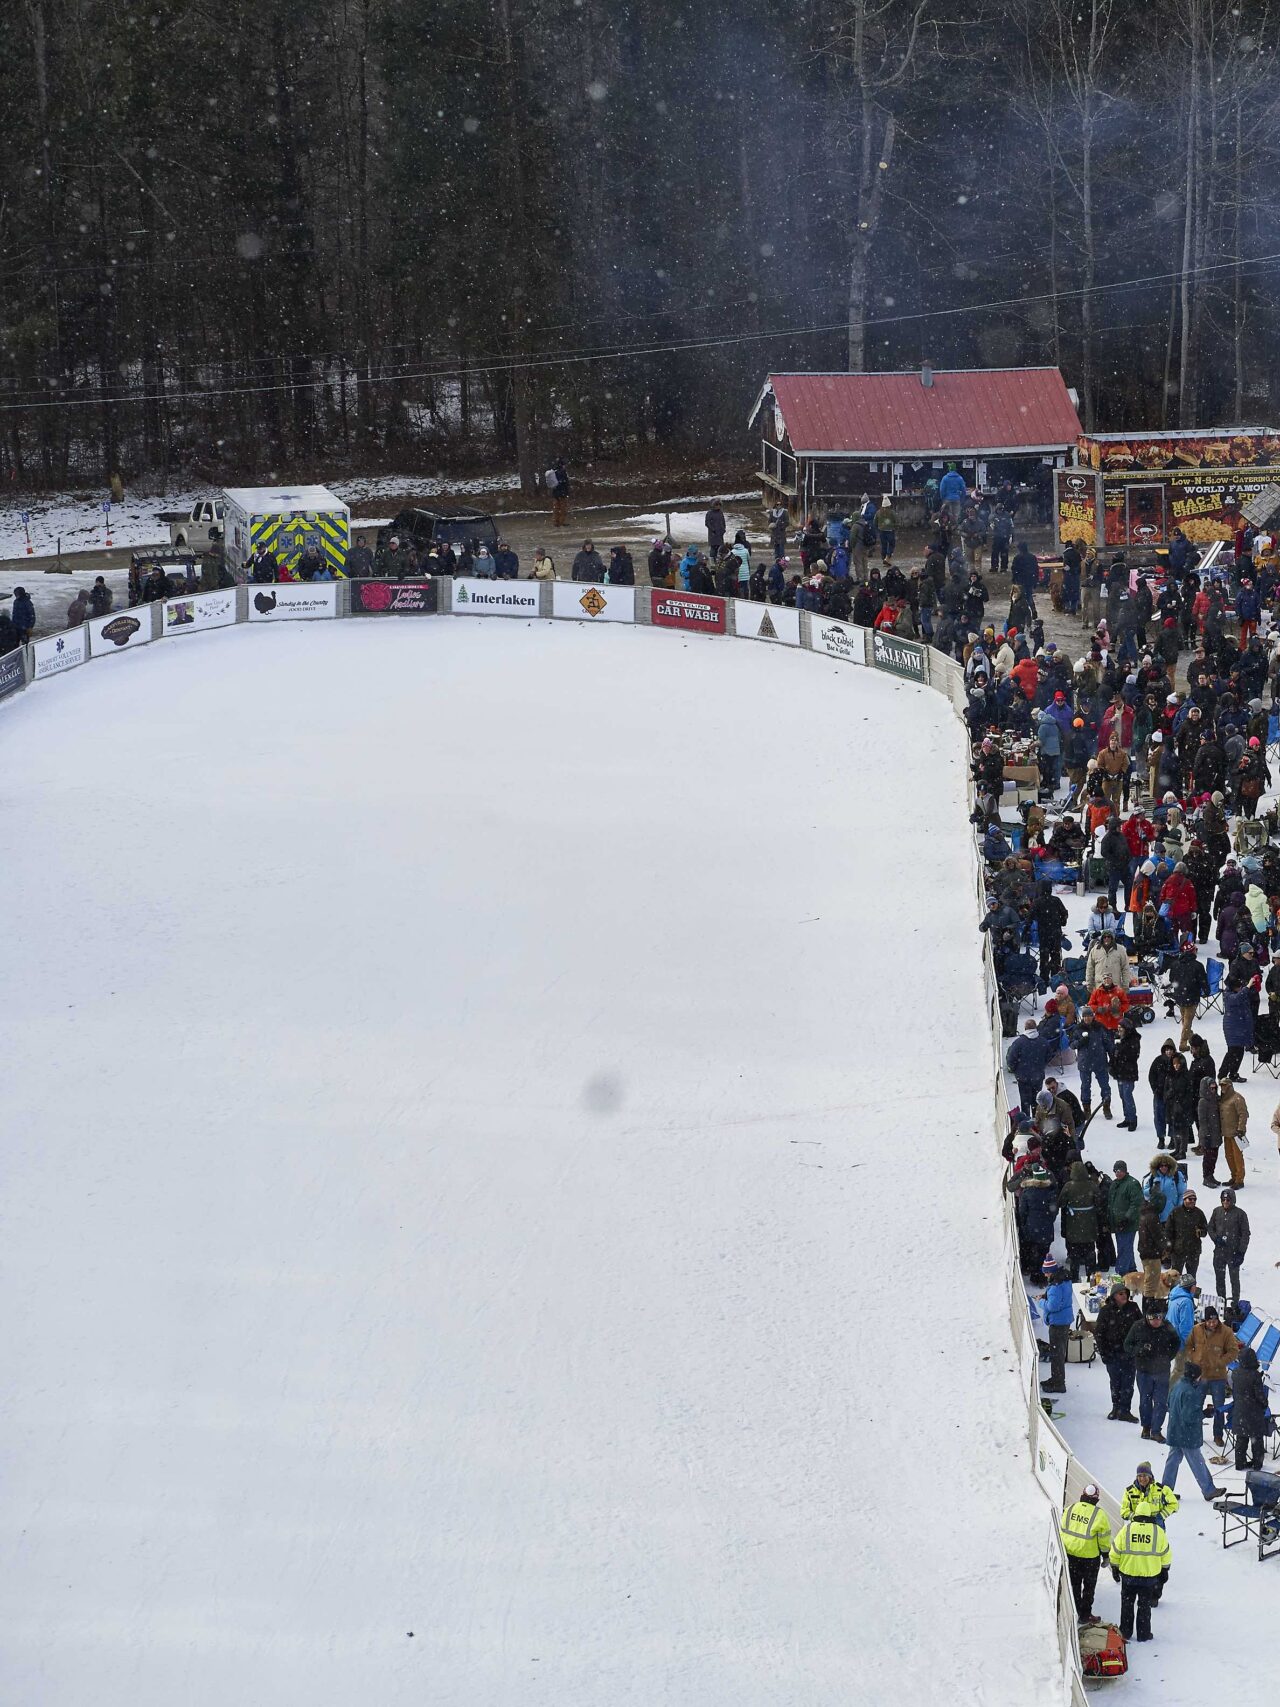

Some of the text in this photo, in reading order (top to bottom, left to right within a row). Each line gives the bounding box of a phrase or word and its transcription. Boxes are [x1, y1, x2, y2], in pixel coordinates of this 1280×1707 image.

[1184, 484, 1269, 494] WORLD FAMOU
[1060, 502, 1094, 515] MAC-N
[1172, 493, 1222, 511] MAC-N
[1224, 495, 1236, 504] &
[1060, 509, 1094, 522] CHEESE
[1173, 502, 1223, 518] CHEESE
[471, 592, 536, 606] Interlaken
[669, 600, 709, 611] STATELINE
[656, 604, 719, 622] CAR WASH
[883, 646, 921, 670] KLEMM
[1070, 1512, 1090, 1525] EMS
[1131, 1533, 1152, 1544] EMS
